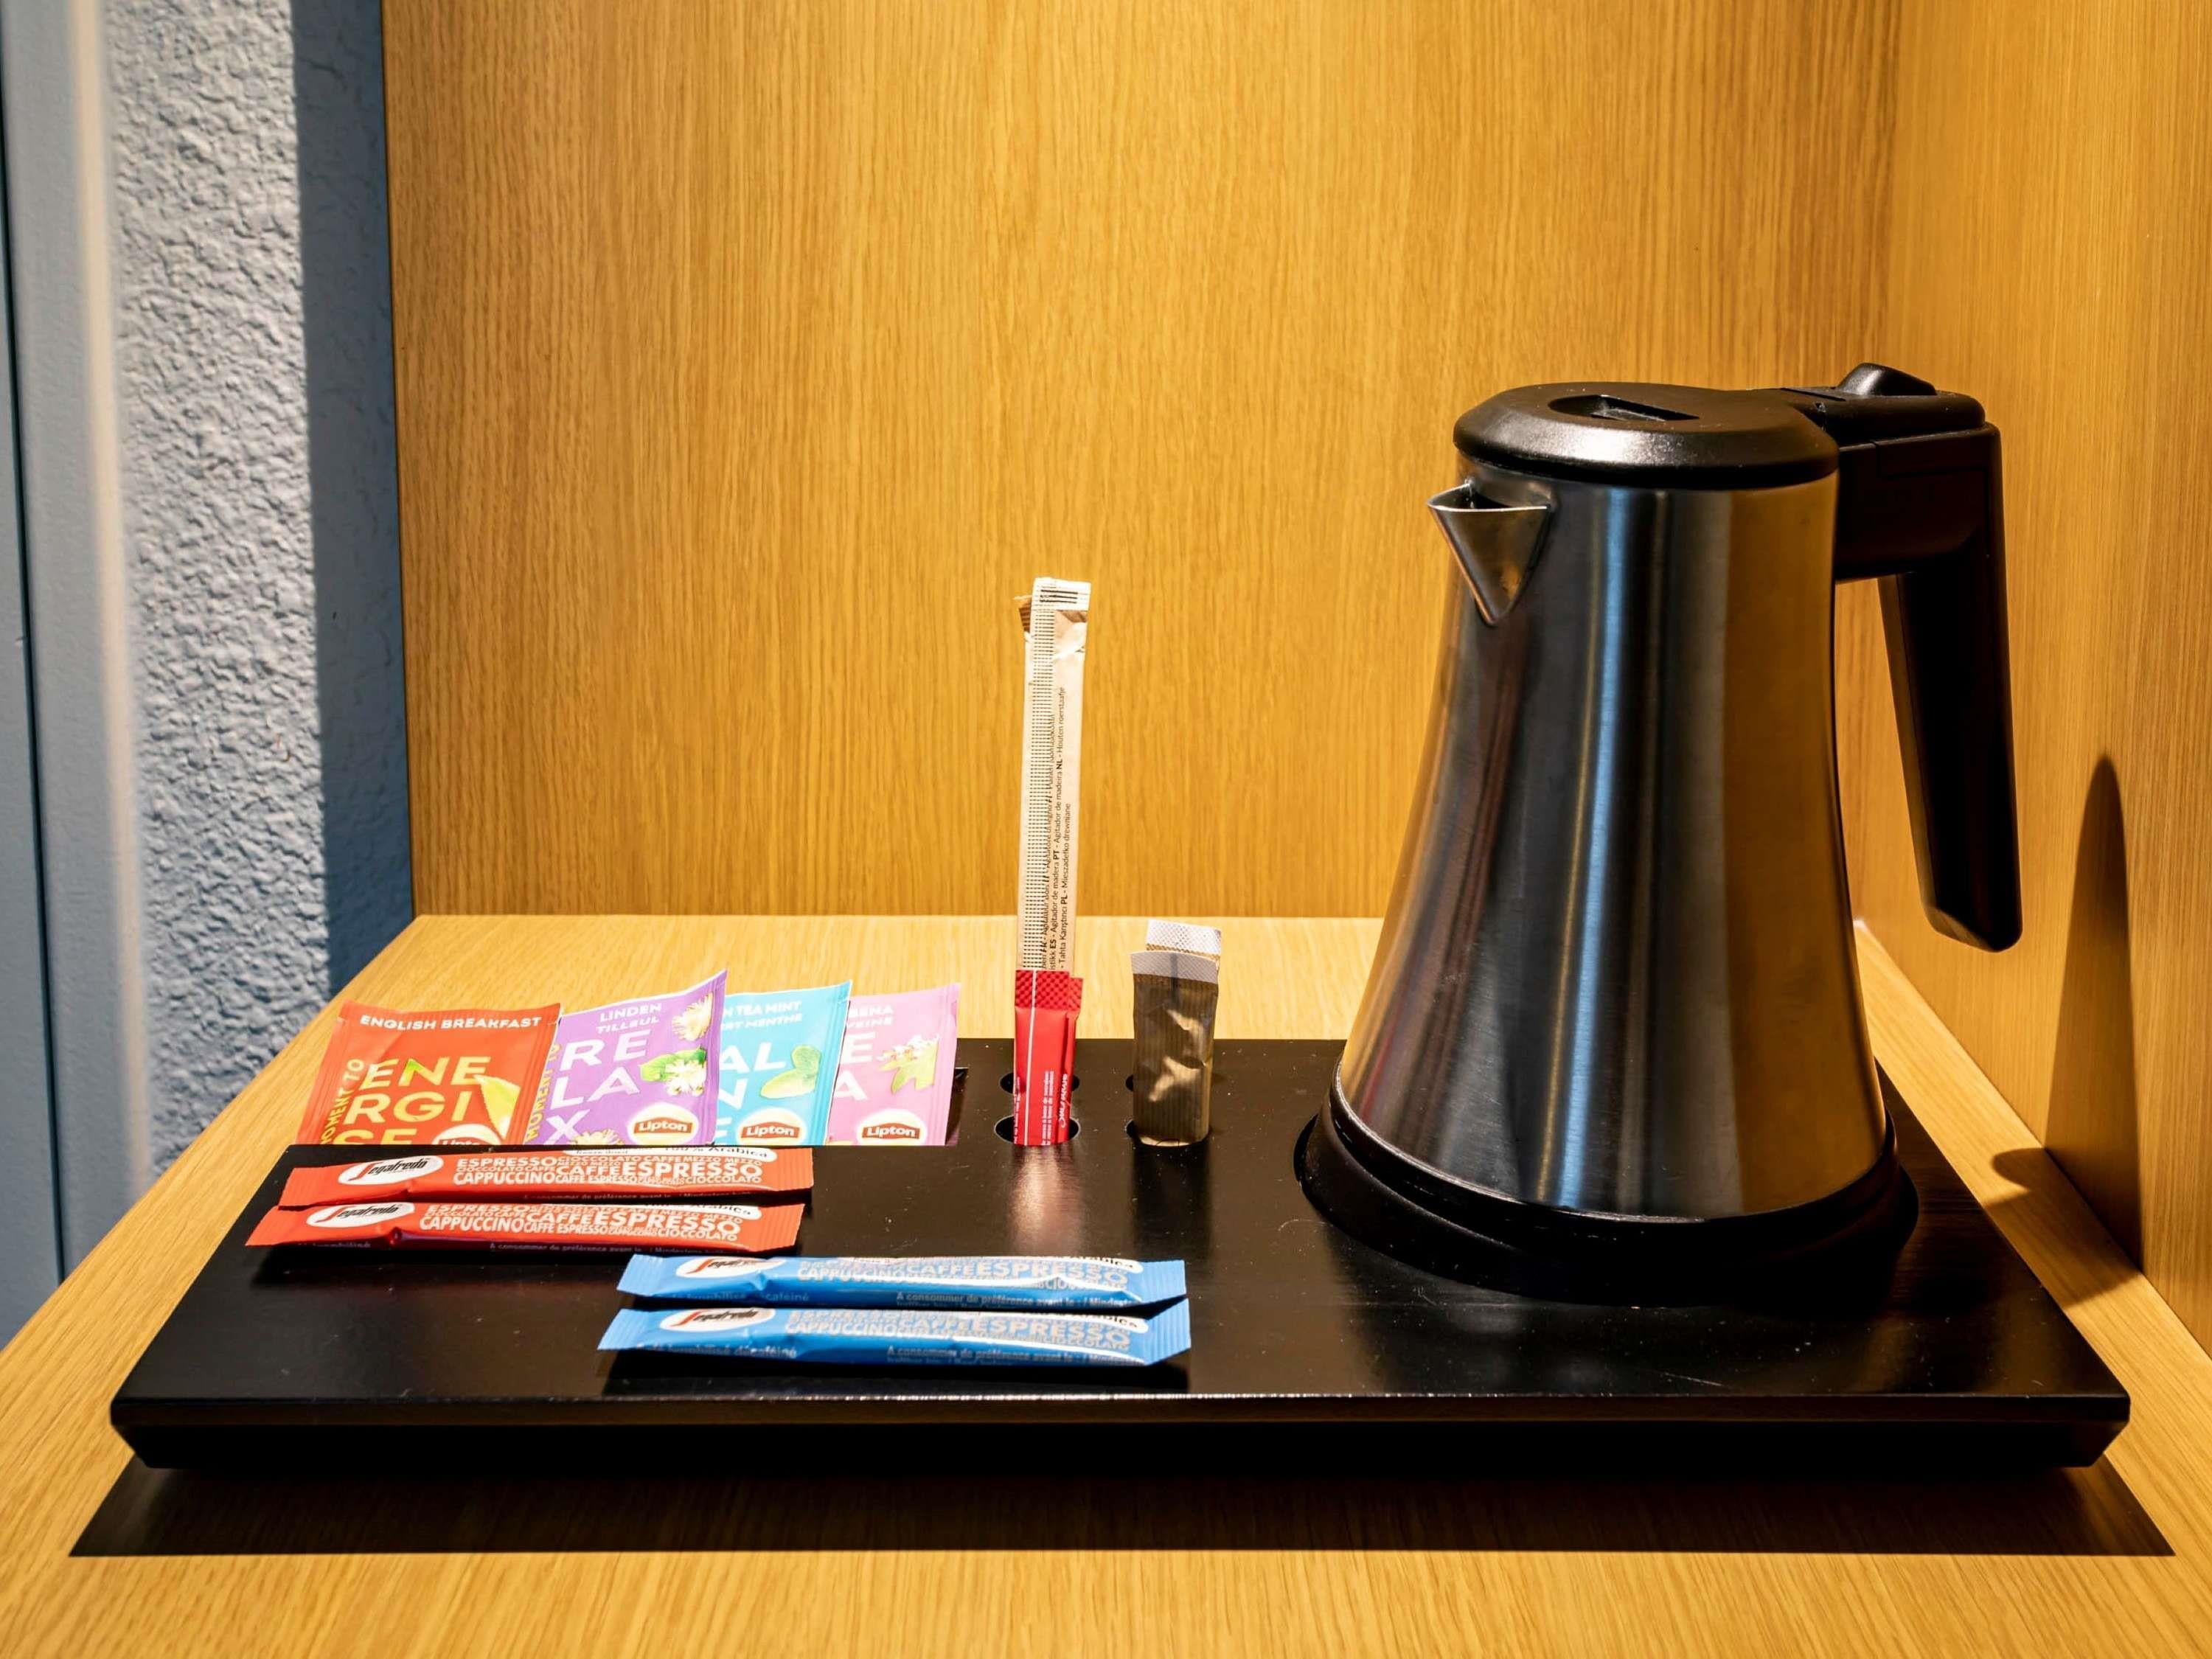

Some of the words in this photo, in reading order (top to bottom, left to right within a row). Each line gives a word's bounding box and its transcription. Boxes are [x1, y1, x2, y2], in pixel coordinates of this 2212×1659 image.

[1058, 687, 1066, 725] roerstaafje
[1056, 759, 1063, 770] NL
[1054, 801, 1062, 811] de
[1053, 813, 1062, 844] Agitador
[1062, 804, 1071, 841] drewniane
[1052, 850, 1060, 860] PT
[1051, 862, 1060, 889] madera
[1051, 891, 1059, 900] de
[1060, 895, 1068, 905] PL
[1050, 902, 1060, 933] Agitador
[1050, 939, 1057, 949] ES
[599, 1003, 663, 1023] LINDEN
[736, 1004, 762, 1016] TEA
[765, 1001, 803, 1014] MINT
[360, 1015, 437, 1030] ENGLISH
[442, 1016, 543, 1029] BREAKFAST
[596, 1016, 660, 1034] TILLEUL
[745, 1013, 803, 1029] MENTHE
[560, 1029, 652, 1072] RE
[342, 1058, 365, 1082] TO
[359, 1056, 491, 1091] ENE
[550, 1066, 641, 1110] LA
[343, 1091, 473, 1125] RGI
[543, 1108, 591, 1144] X
[639, 1120, 689, 1133] Lipton
[745, 1124, 796, 1136] Lipton
[866, 1125, 916, 1138] Lipton
[348, 1157, 430, 1181] Segafredo
[456, 1156, 557, 1167] ESPRESSO
[556, 1166, 620, 1176] CAFFE
[622, 1161, 763, 1178] ESPRESSO
[453, 1172, 555, 1186] CAPPUCCINO
[684, 1175, 762, 1184] CIOCCOLATO
[314, 1204, 400, 1223] Segafredo
[428, 1204, 530, 1212] ESPRESSO
[420, 1217, 524, 1233] CAPPUCCINO
[526, 1213, 592, 1225] CAFFE
[594, 1211, 741, 1234] ESPRESSO
[524, 1222, 554, 1233] CAFFE
[557, 1223, 608, 1235] ESPRESSO
[658, 1227, 738, 1242] CIOCCOLATO
[977, 1260, 1128, 1287] ESPRESSO
[785, 1321, 898, 1336] CAPPUCCINO
[973, 1318, 1130, 1346] ESPRESSO
